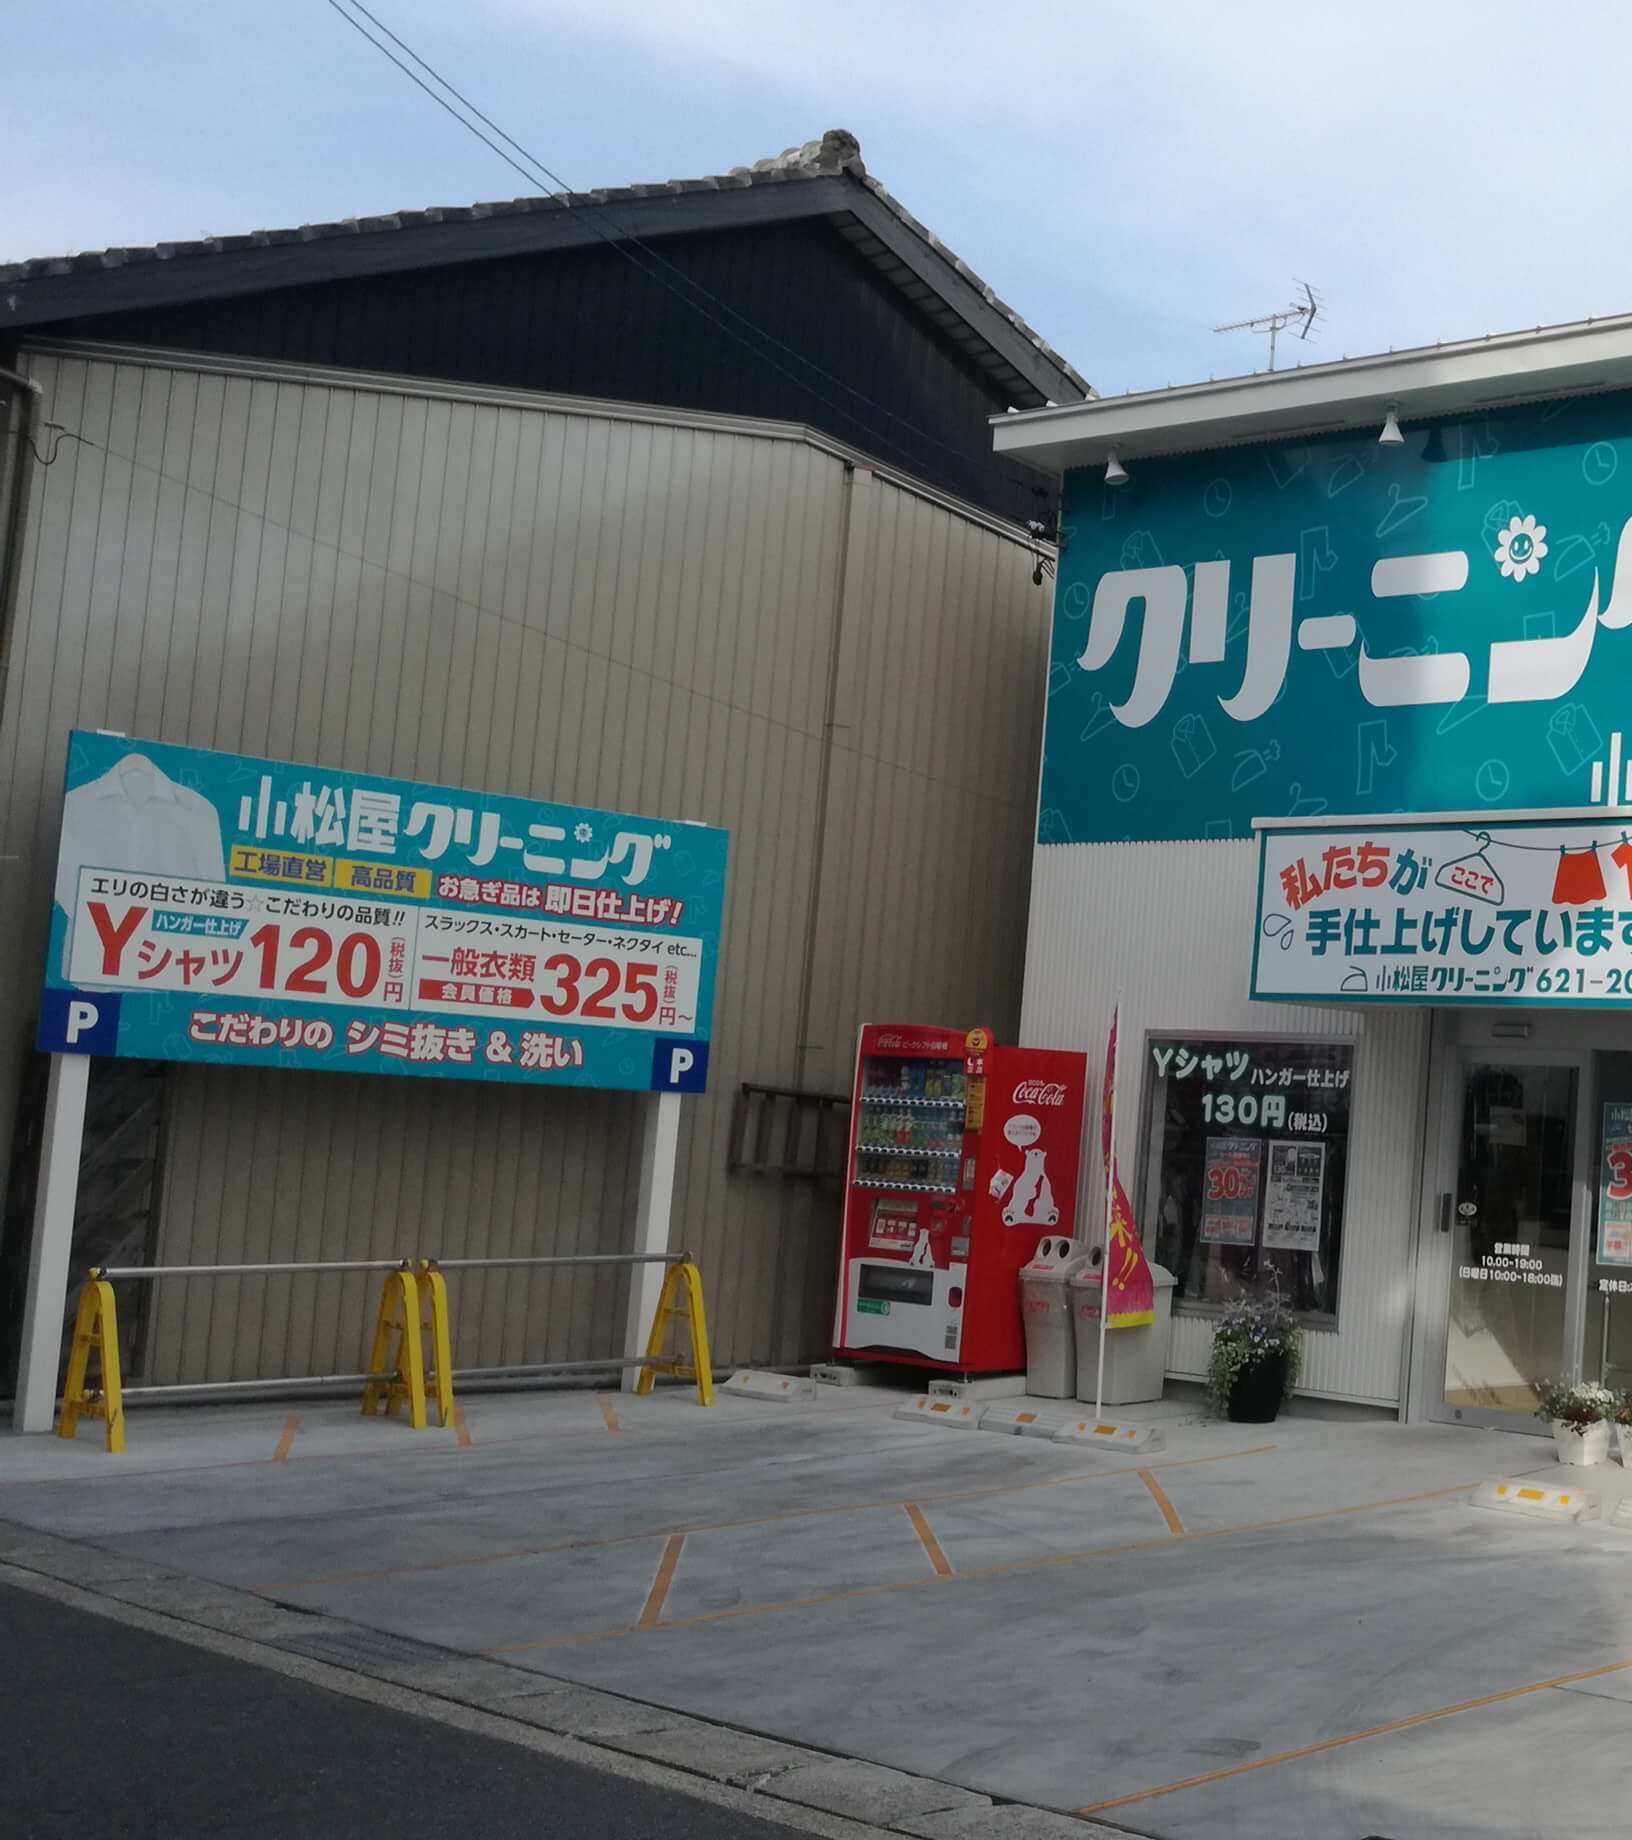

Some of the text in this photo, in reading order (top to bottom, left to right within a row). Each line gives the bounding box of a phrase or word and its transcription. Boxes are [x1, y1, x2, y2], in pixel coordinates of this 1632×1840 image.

[238, 775, 672, 886] 小松屋クリーニング
[233, 850, 415, 894] 工場直営 高品質
[438, 875, 542, 908] お急ぎ品は
[1279, 841, 1432, 911] 私たちが
[1450, 865, 1494, 895] ここで
[156, 913, 242, 936] ハンガー仕上げ
[250, 922, 382, 999] 120
[1375, 964, 1534, 994] 小松屋クリーニング
[383, 981, 404, 1003] 円
[421, 946, 660, 1023] 一般衣類 325
[441, 983, 513, 1005] 会員価格
[66, 1001, 99, 1043] P
[189, 1010, 583, 1069] こだわりの シミ抜き & 洗い
[669, 1047, 694, 1084] P
[1153, 1048, 1350, 1088] Yシャツ ハンガー仕上げ
[1012, 1081, 1068, 1106] Coca-Cola
[1202, 1093, 1328, 1133] 130円 (税込)
